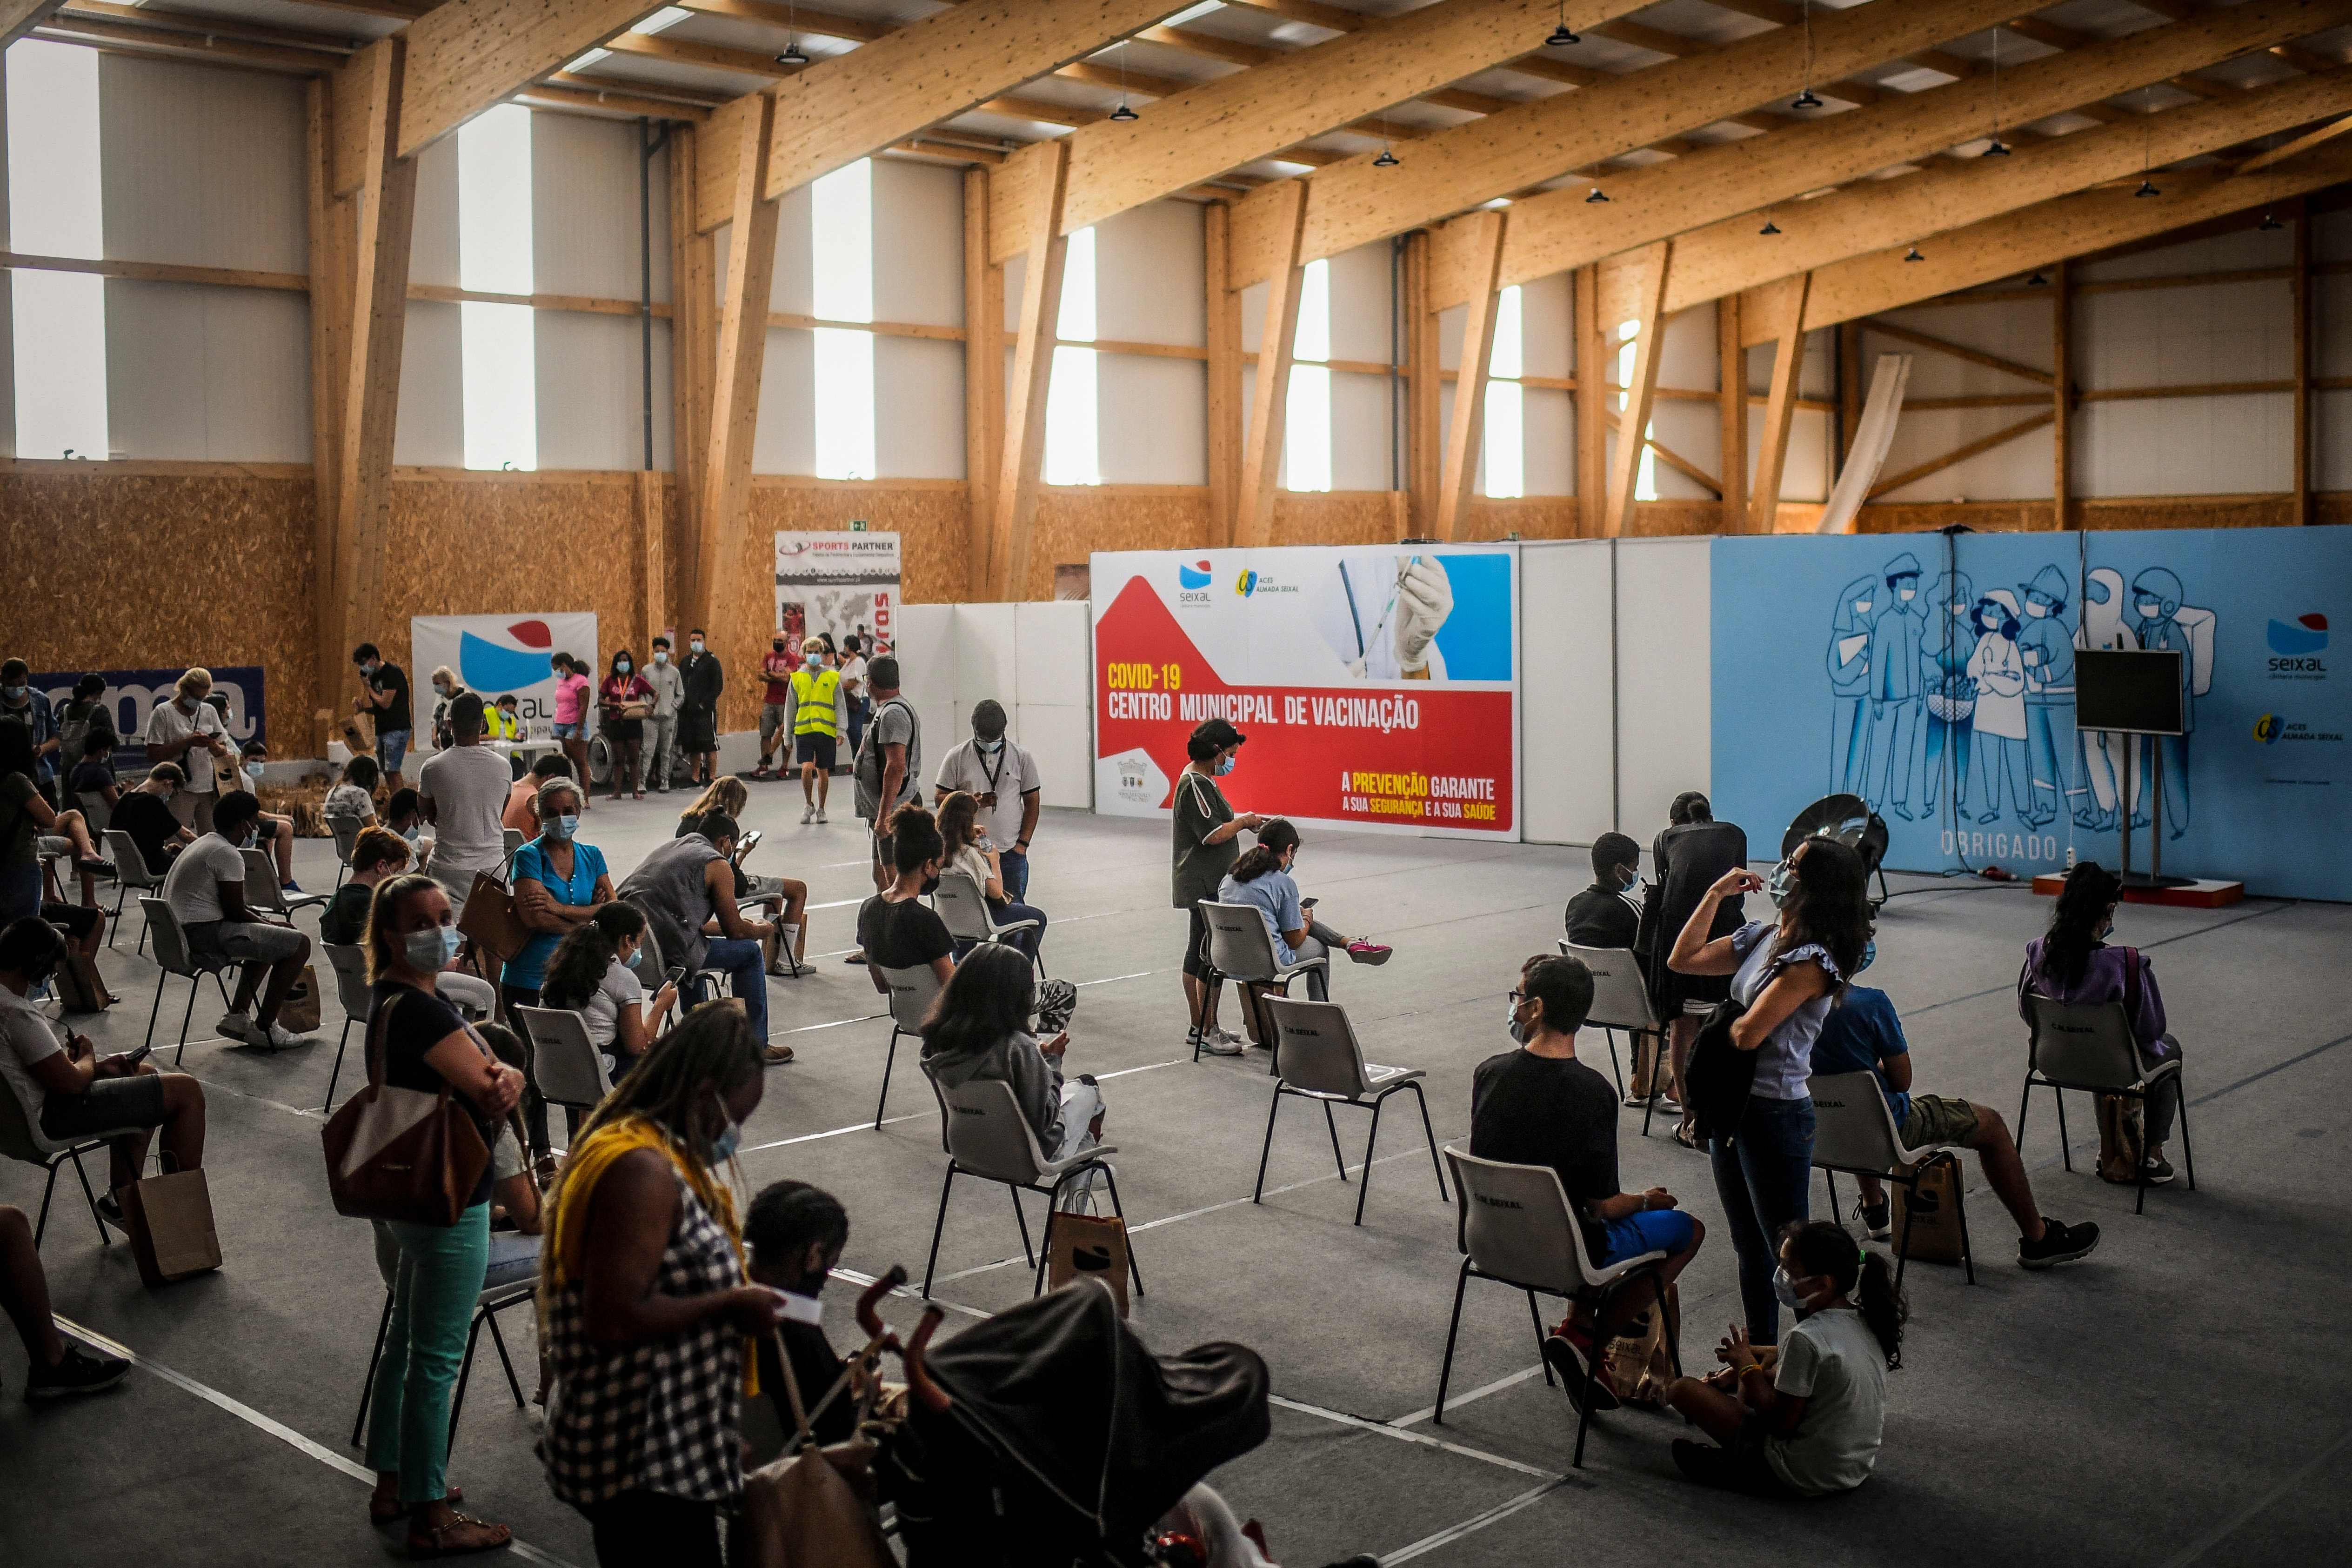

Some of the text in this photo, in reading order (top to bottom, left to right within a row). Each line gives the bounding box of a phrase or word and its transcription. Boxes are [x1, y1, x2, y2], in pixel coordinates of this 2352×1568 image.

[813, 542, 893, 551] SPORTS PARTNER
[1180, 592, 1211, 602] seixal
[1108, 663, 1181, 690] COVID-19
[2268, 657, 2326, 672] seixal
[1109, 692, 1418, 734] CENTRO MUNICIPAL DE VACINAÇÃO
[1341, 771, 1495, 801] A PREVENÇÃO GARANTE
[1343, 796, 1496, 821] A SUA SEGURANÇA E A SUA SAÚDE
[1941, 830, 2057, 861] OBRIGADO
